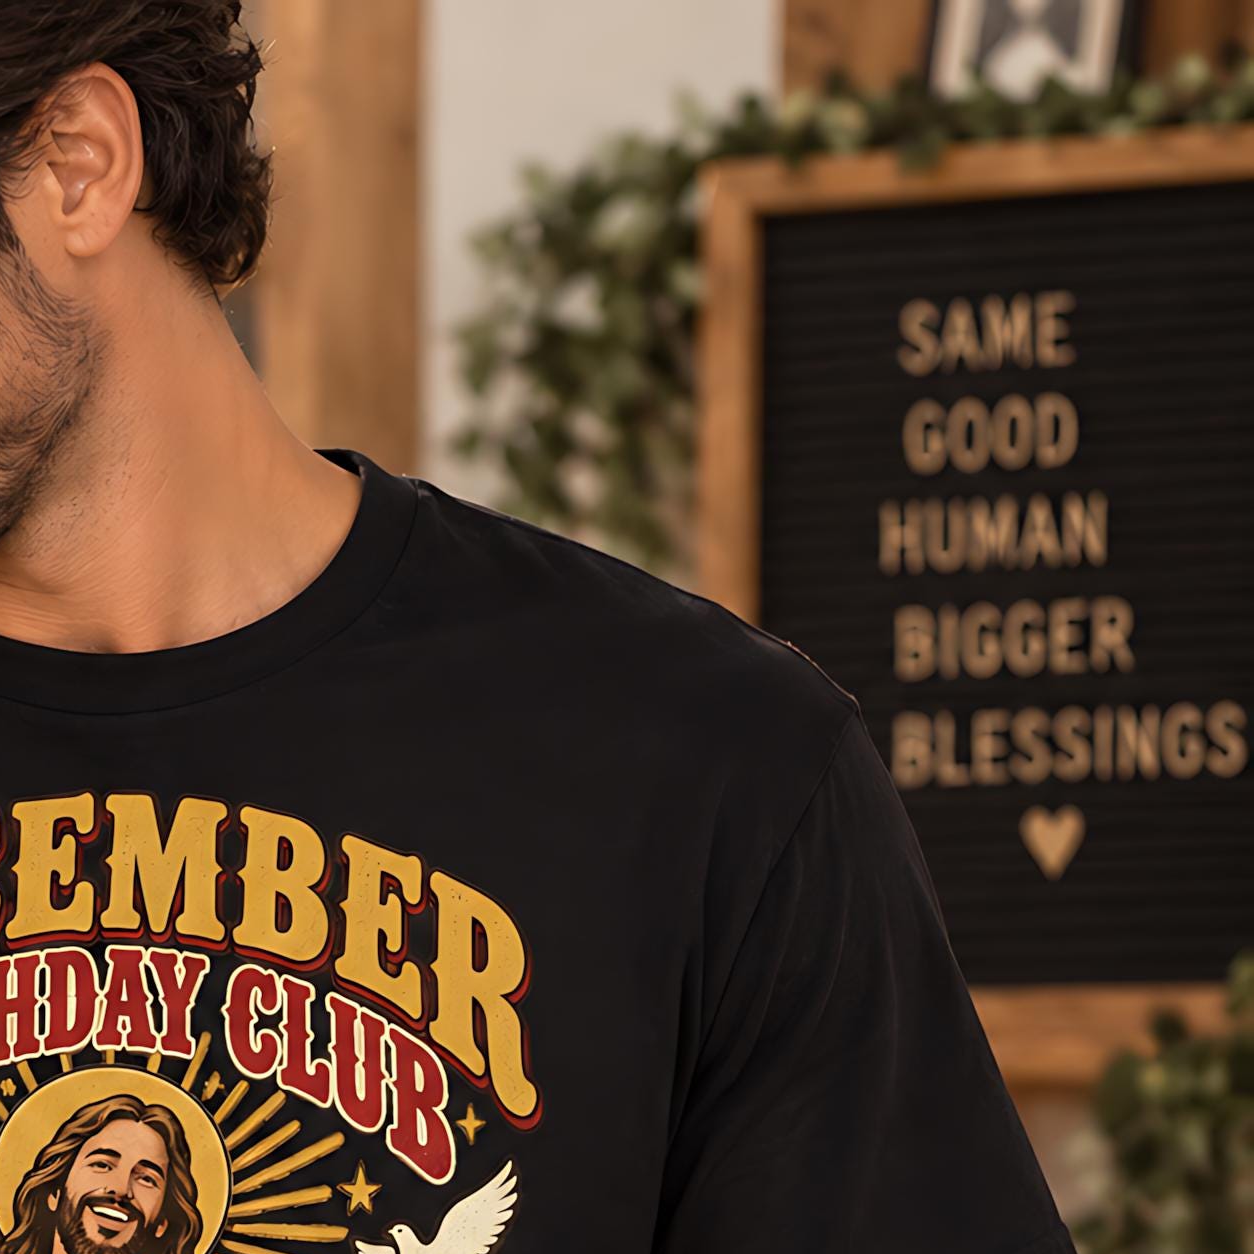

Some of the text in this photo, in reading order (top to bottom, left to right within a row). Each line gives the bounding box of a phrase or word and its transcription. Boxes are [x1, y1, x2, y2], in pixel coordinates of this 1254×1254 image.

[898, 290, 1077, 377] SAME
[903, 392, 1080, 475] GOOD
[879, 489, 1109, 575] HUMAN
[893, 596, 1135, 683] BIGGER
[890, 699, 1248, 789] BLESSINGS
[223, 963, 457, 1187] CLUB
